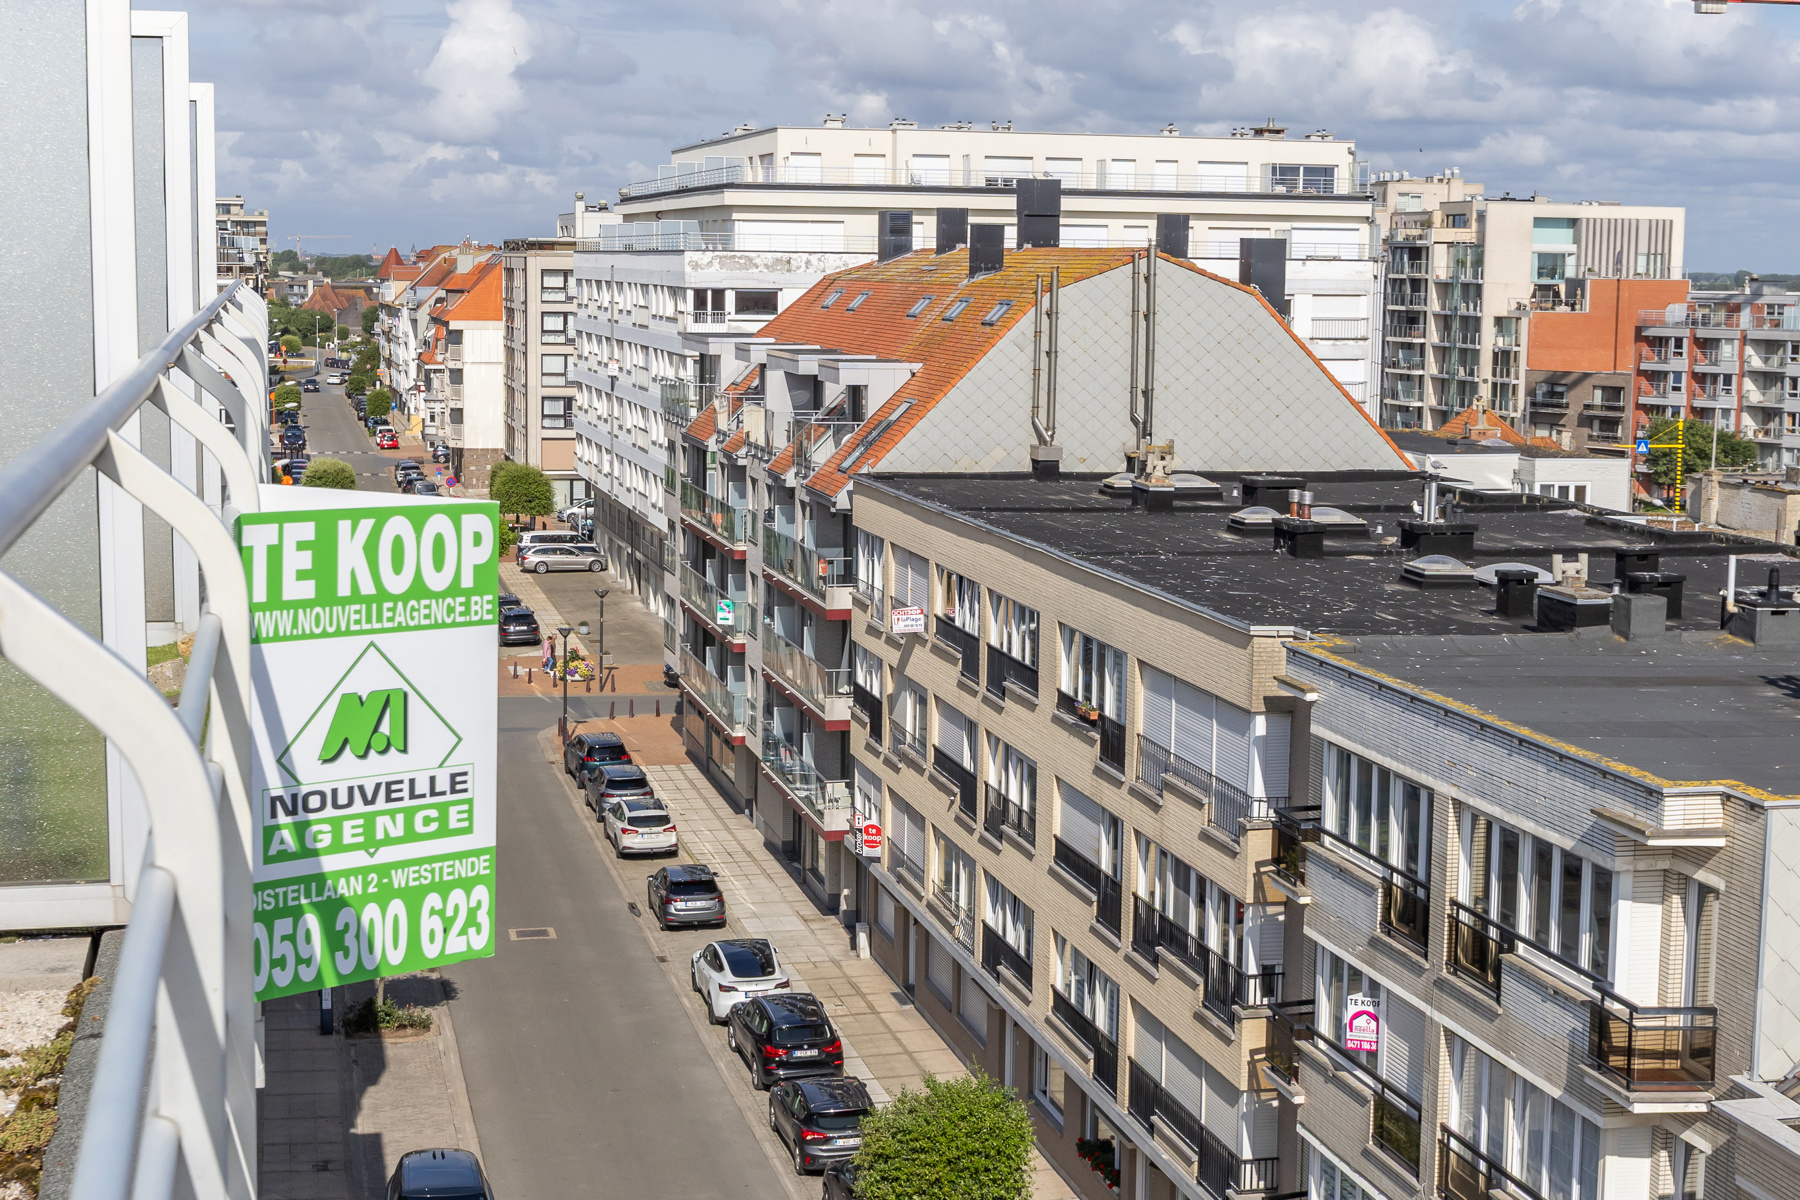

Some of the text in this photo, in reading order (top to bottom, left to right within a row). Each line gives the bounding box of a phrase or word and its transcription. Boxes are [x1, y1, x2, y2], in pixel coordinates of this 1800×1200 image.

[242, 513, 494, 603] TE KOOP
[270, 771, 469, 820] NOUVELLE
[267, 804, 470, 856] AGENCE
[253, 875, 363, 911] ISTELLAAN
[367, 873, 378, 893] 2
[391, 855, 491, 889] WESTENDE
[253, 884, 490, 992] 059 300 623
[1349, 998, 1358, 1006] TE
